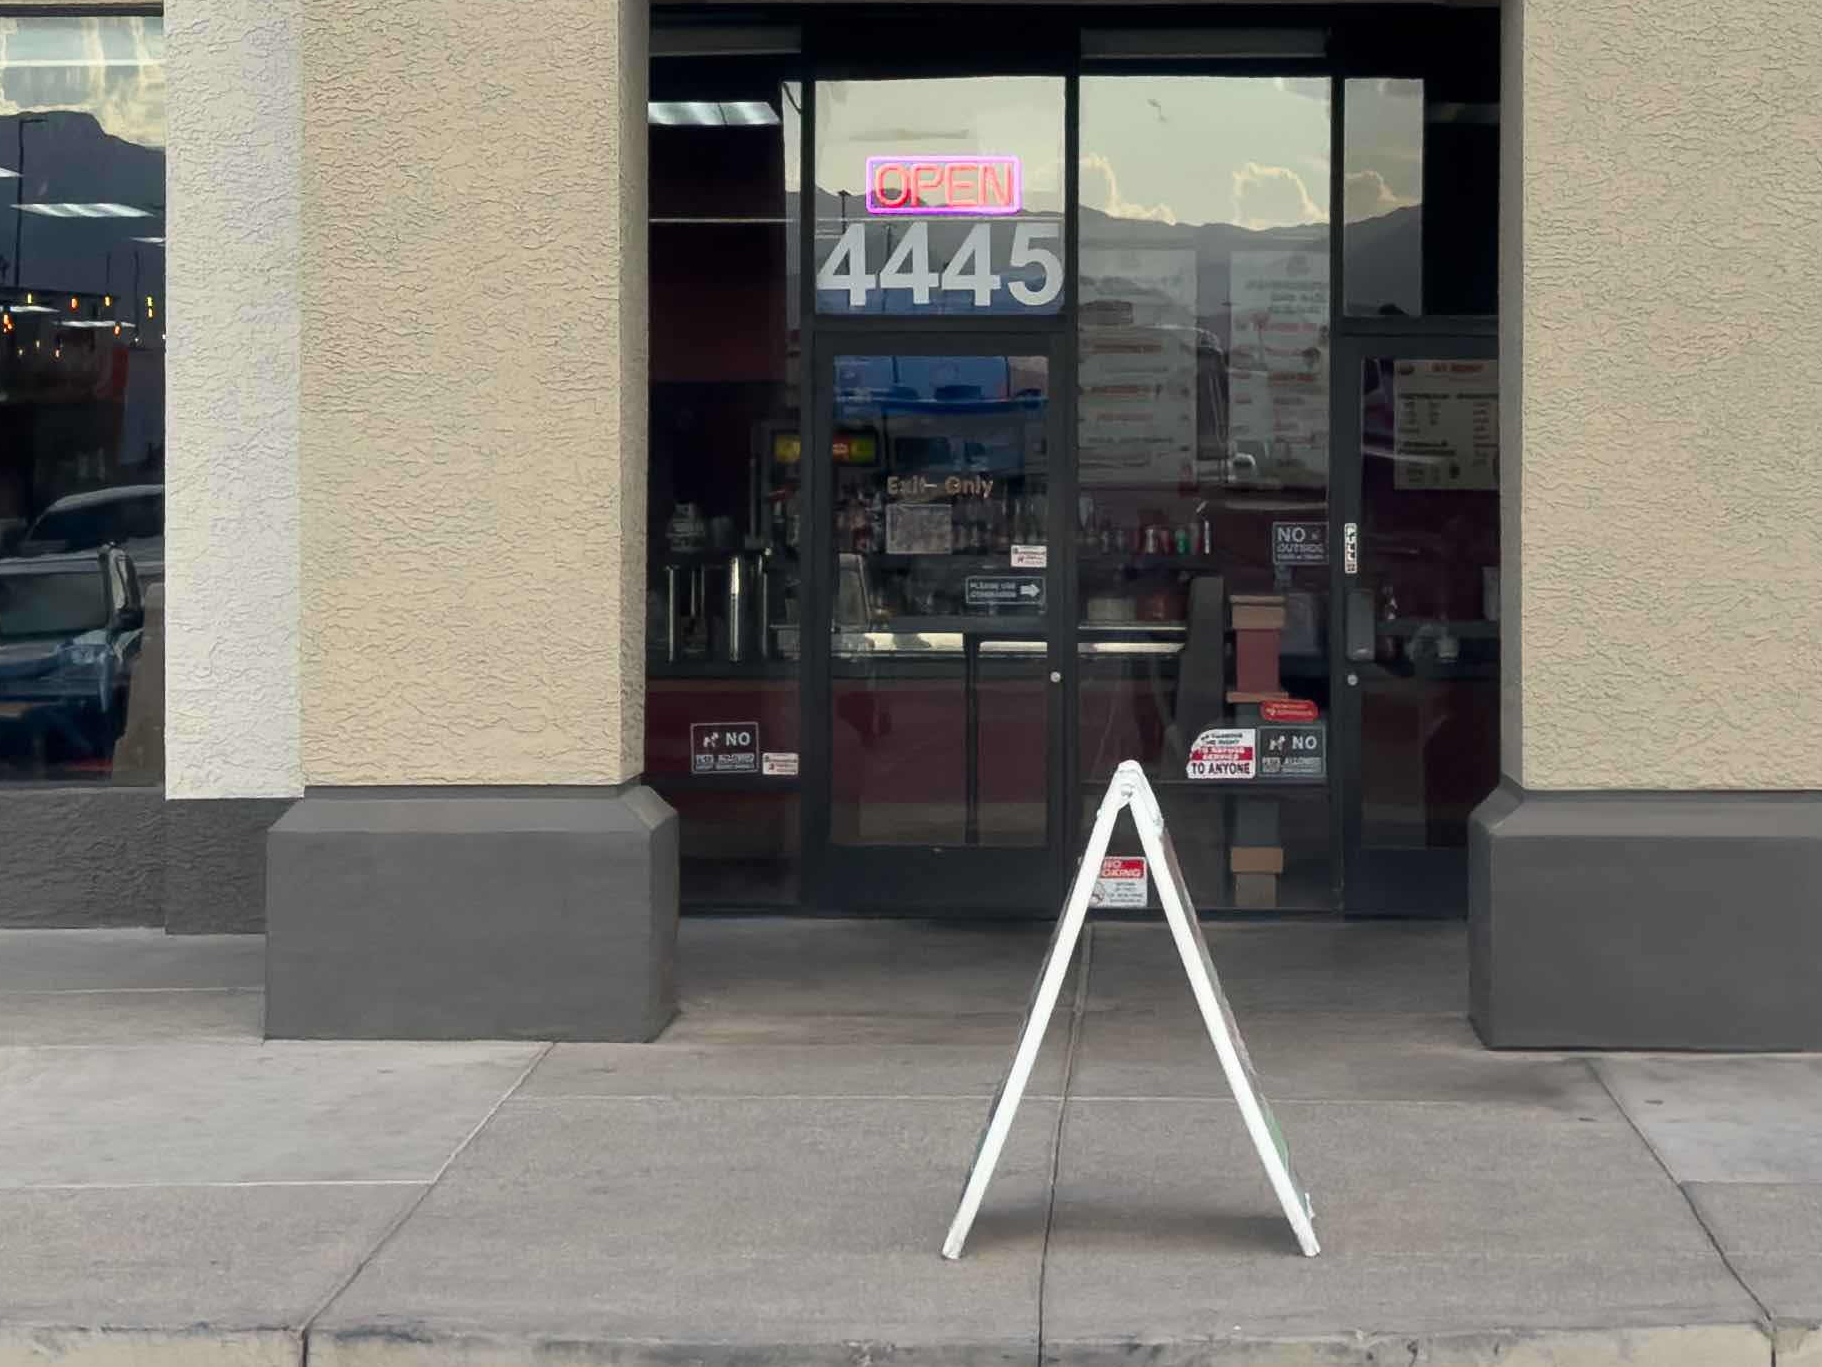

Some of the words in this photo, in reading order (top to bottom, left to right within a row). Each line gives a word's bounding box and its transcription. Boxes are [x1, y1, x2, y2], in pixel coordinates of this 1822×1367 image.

[875, 163, 1014, 208] OPEN
[817, 221, 1065, 307] 4445
[945, 475, 994, 498] Only
[1278, 527, 1306, 542] NO
[726, 732, 751, 746] NO
[1292, 736, 1317, 749] NO
[1191, 764, 1204, 774] TO
[1208, 763, 1250, 774] ANYONE
